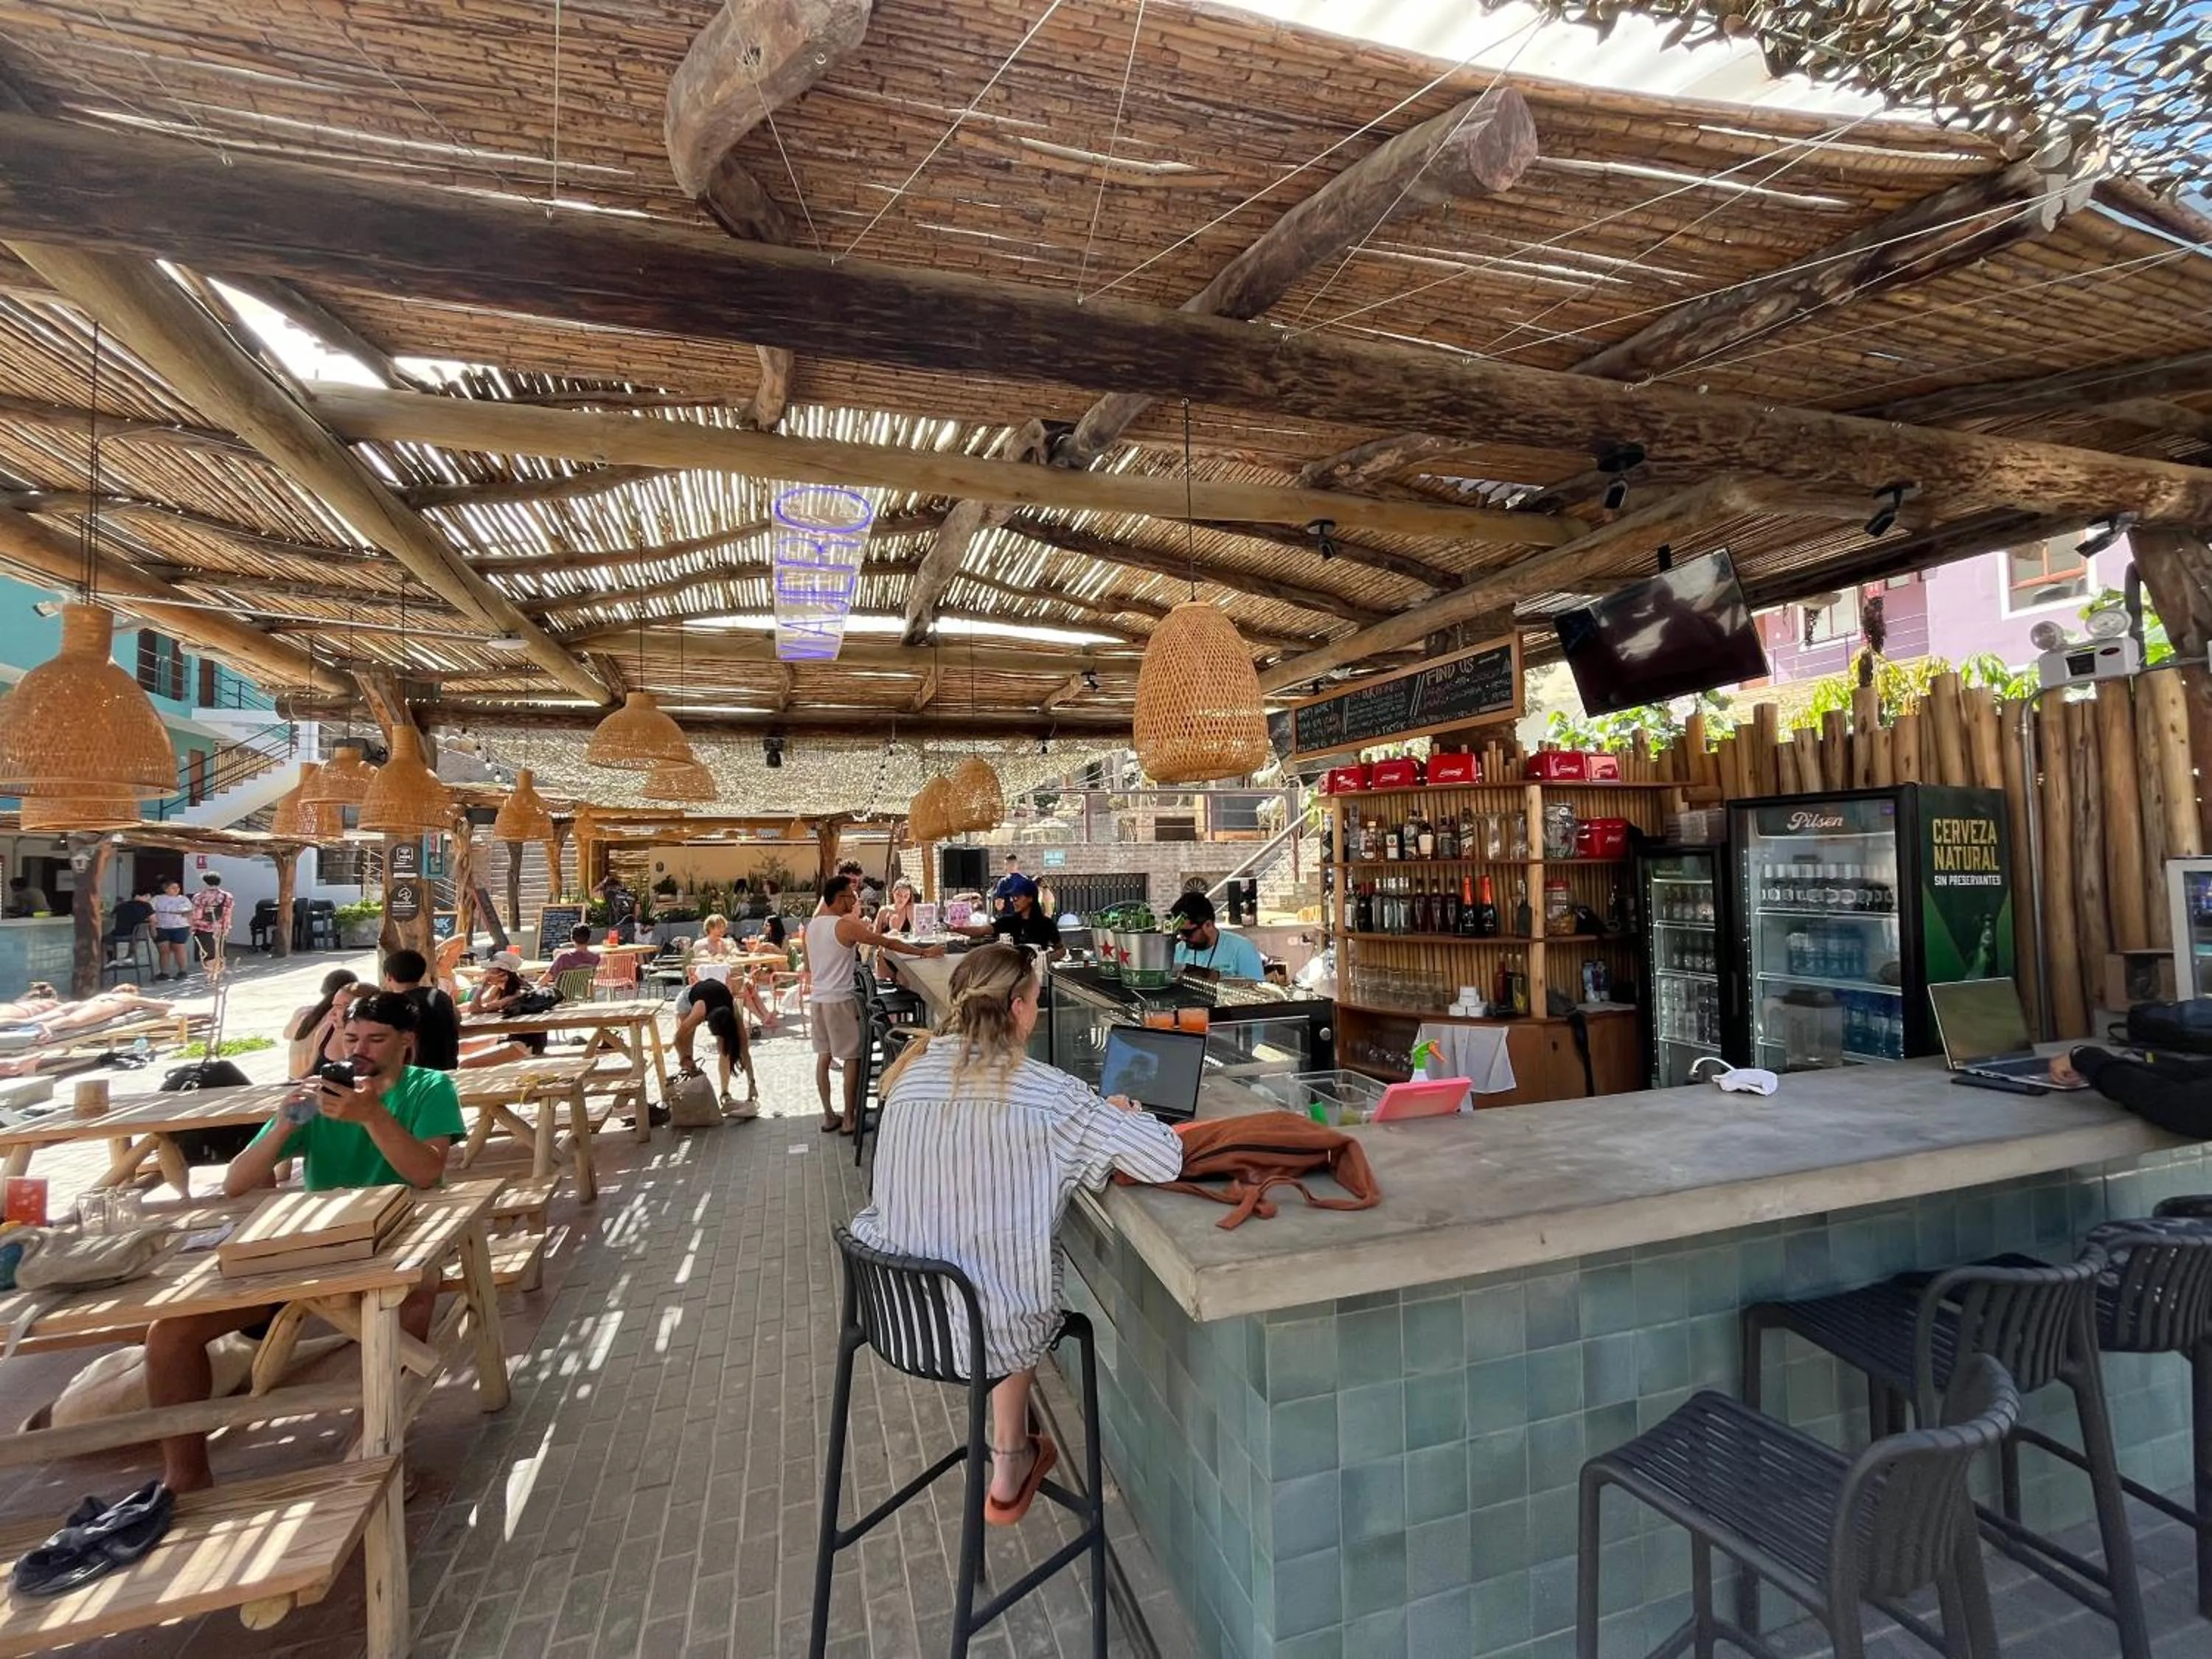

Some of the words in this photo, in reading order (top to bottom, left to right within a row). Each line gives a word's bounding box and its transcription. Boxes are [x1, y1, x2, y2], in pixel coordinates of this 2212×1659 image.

[1426, 664, 1456, 686] FIND
[1459, 657, 1474, 673] US
[1787, 811, 1844, 830] Pilsen
[1932, 818, 1997, 844] CERVEZA
[1933, 846, 2000, 871] NATURAL
[1934, 874, 1947, 886] SIN
[1949, 874, 2002, 886] PRESERVANTES
